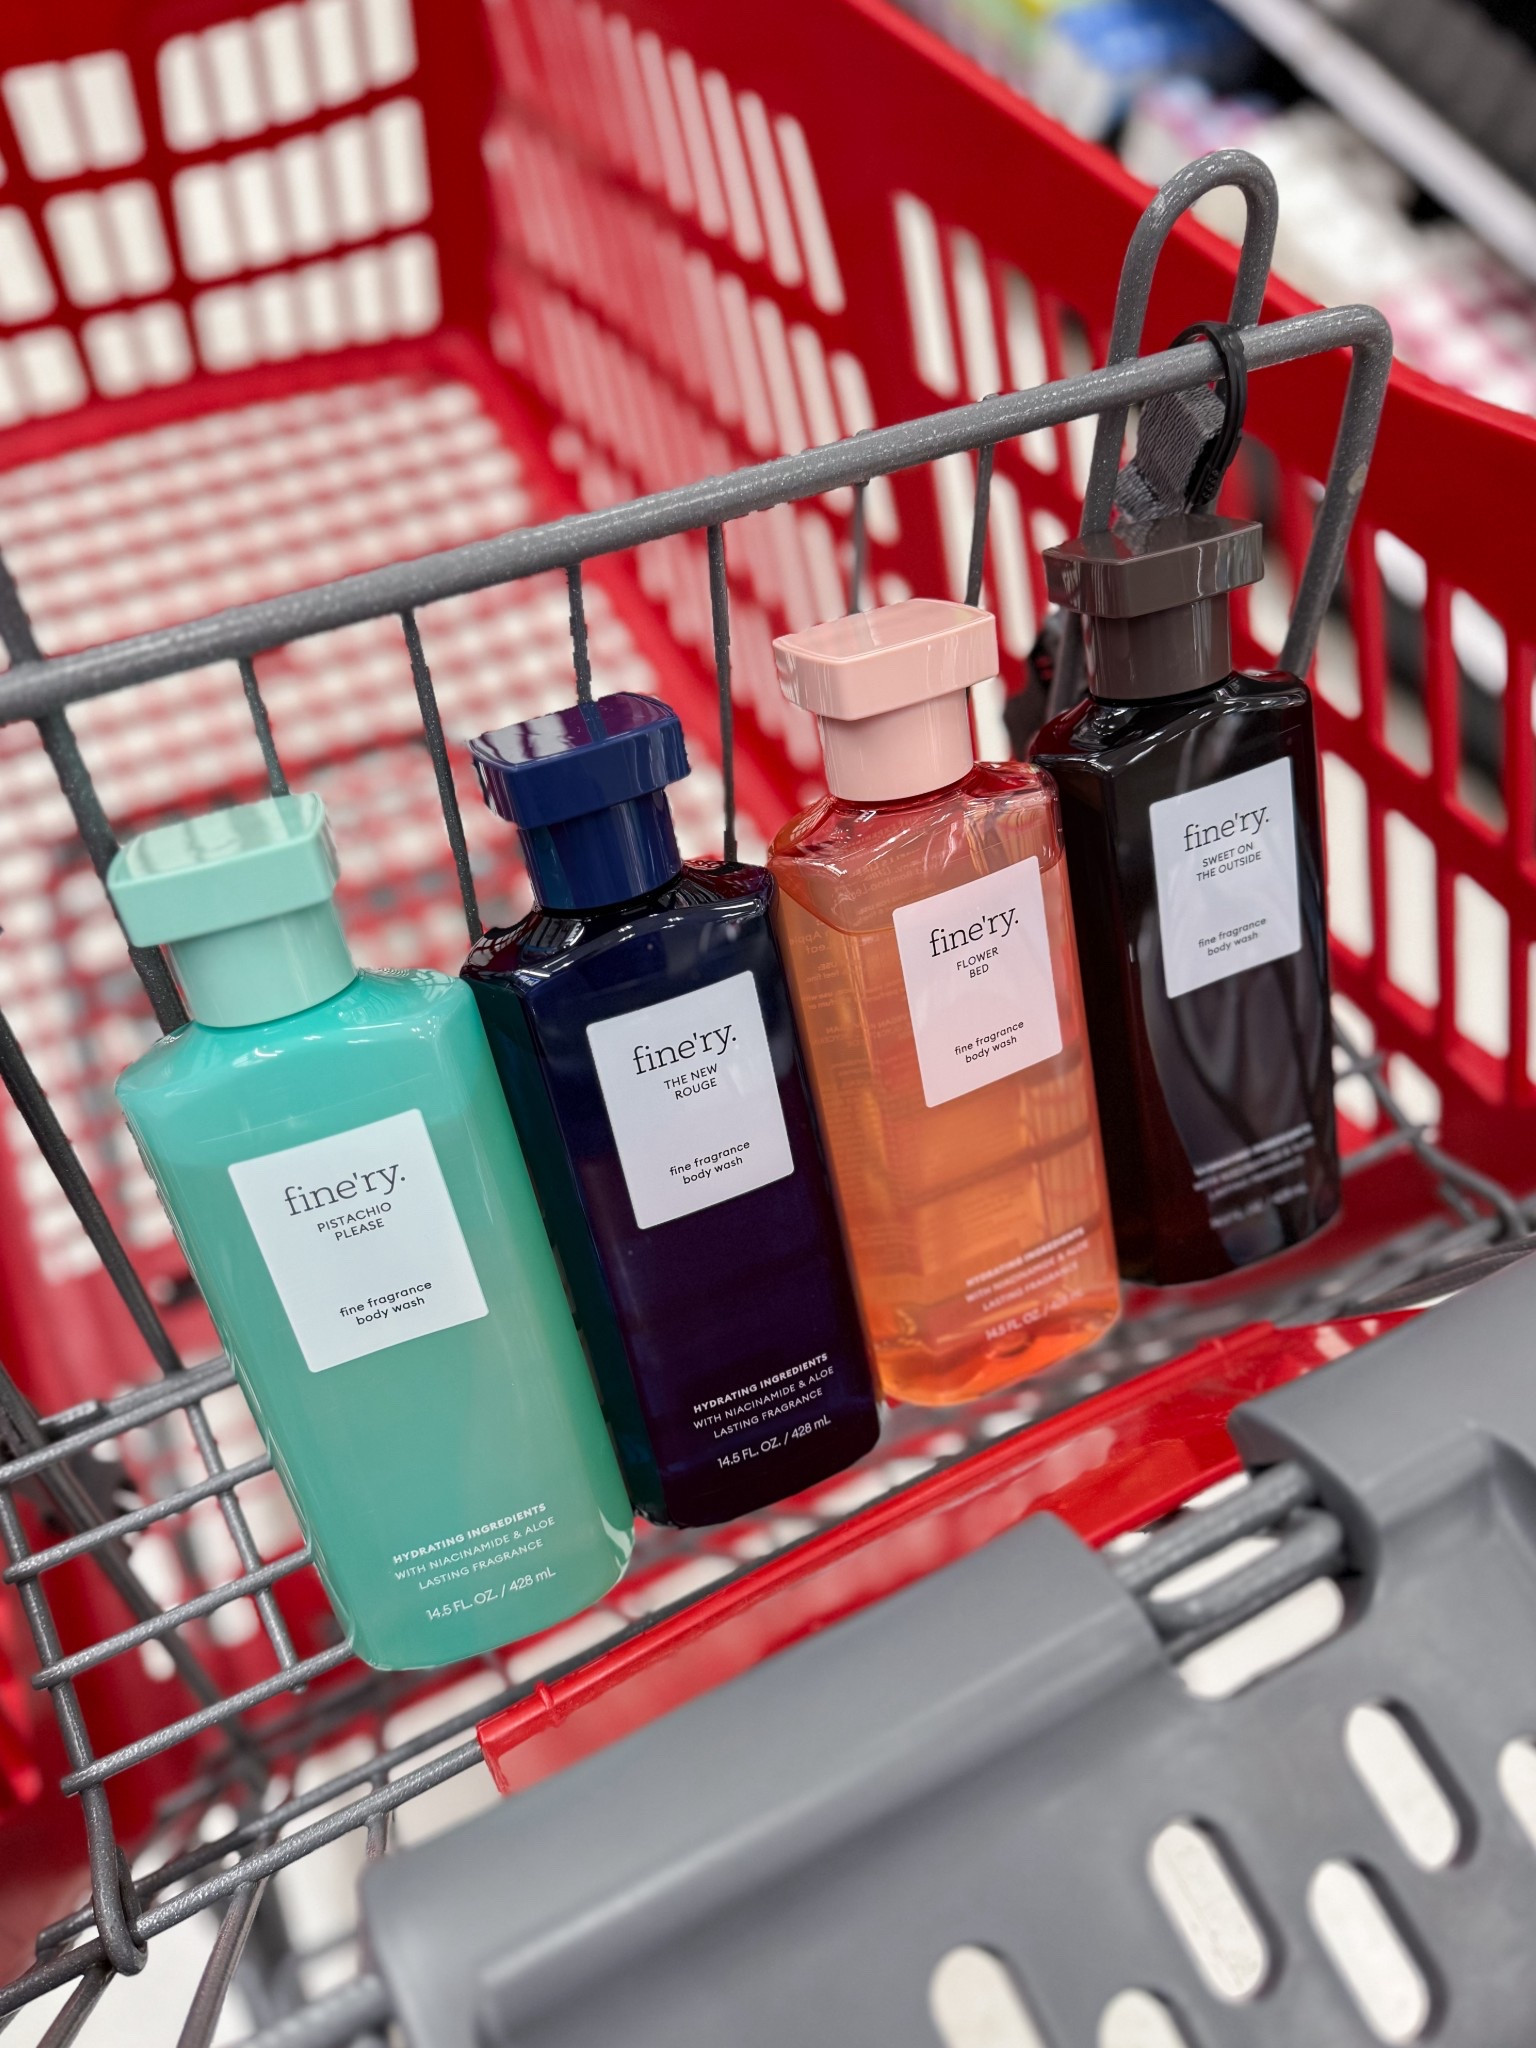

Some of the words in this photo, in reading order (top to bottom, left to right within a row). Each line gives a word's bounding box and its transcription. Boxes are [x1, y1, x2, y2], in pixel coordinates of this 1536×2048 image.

[1184, 805, 1269, 852] fine'ry.
[1196, 868, 1216, 882] THE
[1218, 851, 1262, 874] OUTSIDE
[1202, 849, 1235, 868] SWEET
[1237, 842, 1254, 855] ON
[929, 907, 1019, 958] fine'ry.
[1198, 934, 1216, 949] fine
[1218, 917, 1267, 940] fragrance
[1207, 941, 1231, 956] body
[1233, 931, 1258, 947] wash
[956, 946, 999, 971] FLOWER
[969, 963, 989, 978] BED
[632, 1024, 737, 1075] fine'ry.
[954, 1041, 974, 1056] fine
[975, 1020, 1025, 1046] fragrance
[965, 1046, 990, 1063] body
[993, 1035, 1017, 1052] wash
[664, 1074, 688, 1090] THE
[691, 1063, 718, 1080] NEW
[675, 1077, 718, 1100] ROUGE
[669, 1162, 692, 1177] fine
[694, 1140, 750, 1167] fragrance
[683, 1168, 712, 1185] body
[714, 1156, 743, 1172] wash
[284, 1164, 405, 1216] fine'ry.
[316, 1202, 392, 1232] PISTACHIO
[334, 1218, 385, 1241] PLEASE
[339, 1303, 365, 1317] fine
[367, 1281, 432, 1308] fragrance
[356, 1309, 389, 1325] body
[392, 1296, 425, 1313] wash
[693, 1384, 758, 1414] HYDRATING
[760, 1352, 828, 1389] INGREDIENTS
[693, 1413, 722, 1429] WITH
[724, 1384, 796, 1419] NIACINAMIDE
[798, 1379, 806, 1388] &
[808, 1366, 834, 1384] ALOE
[713, 1415, 760, 1439] LASTING
[761, 1387, 823, 1421] FRAGRANCE
[717, 1452, 741, 1469] 14.5
[742, 1447, 759, 1460] FL.
[760, 1436, 782, 1452] OZ.
[783, 1431, 789, 1445] /
[791, 1422, 812, 1439] 428
[813, 1414, 832, 1430] mL
[393, 1534, 465, 1564] HYDRATING
[467, 1503, 546, 1539] INGREDIENTS
[395, 1564, 426, 1580] WITH
[429, 1535, 511, 1570] NIACINAMIDE
[513, 1530, 522, 1539] &
[525, 1516, 556, 1535] ALOE
[418, 1566, 470, 1590] LASTING
[472, 1539, 544, 1571] FRAGRANCE
[426, 1604, 452, 1620] 14.5
[453, 1599, 473, 1613] FL.
[474, 1589, 498, 1605] OZ.
[501, 1584, 506, 1598] /
[509, 1575, 534, 1591] 428
[535, 1566, 557, 1582] mL
